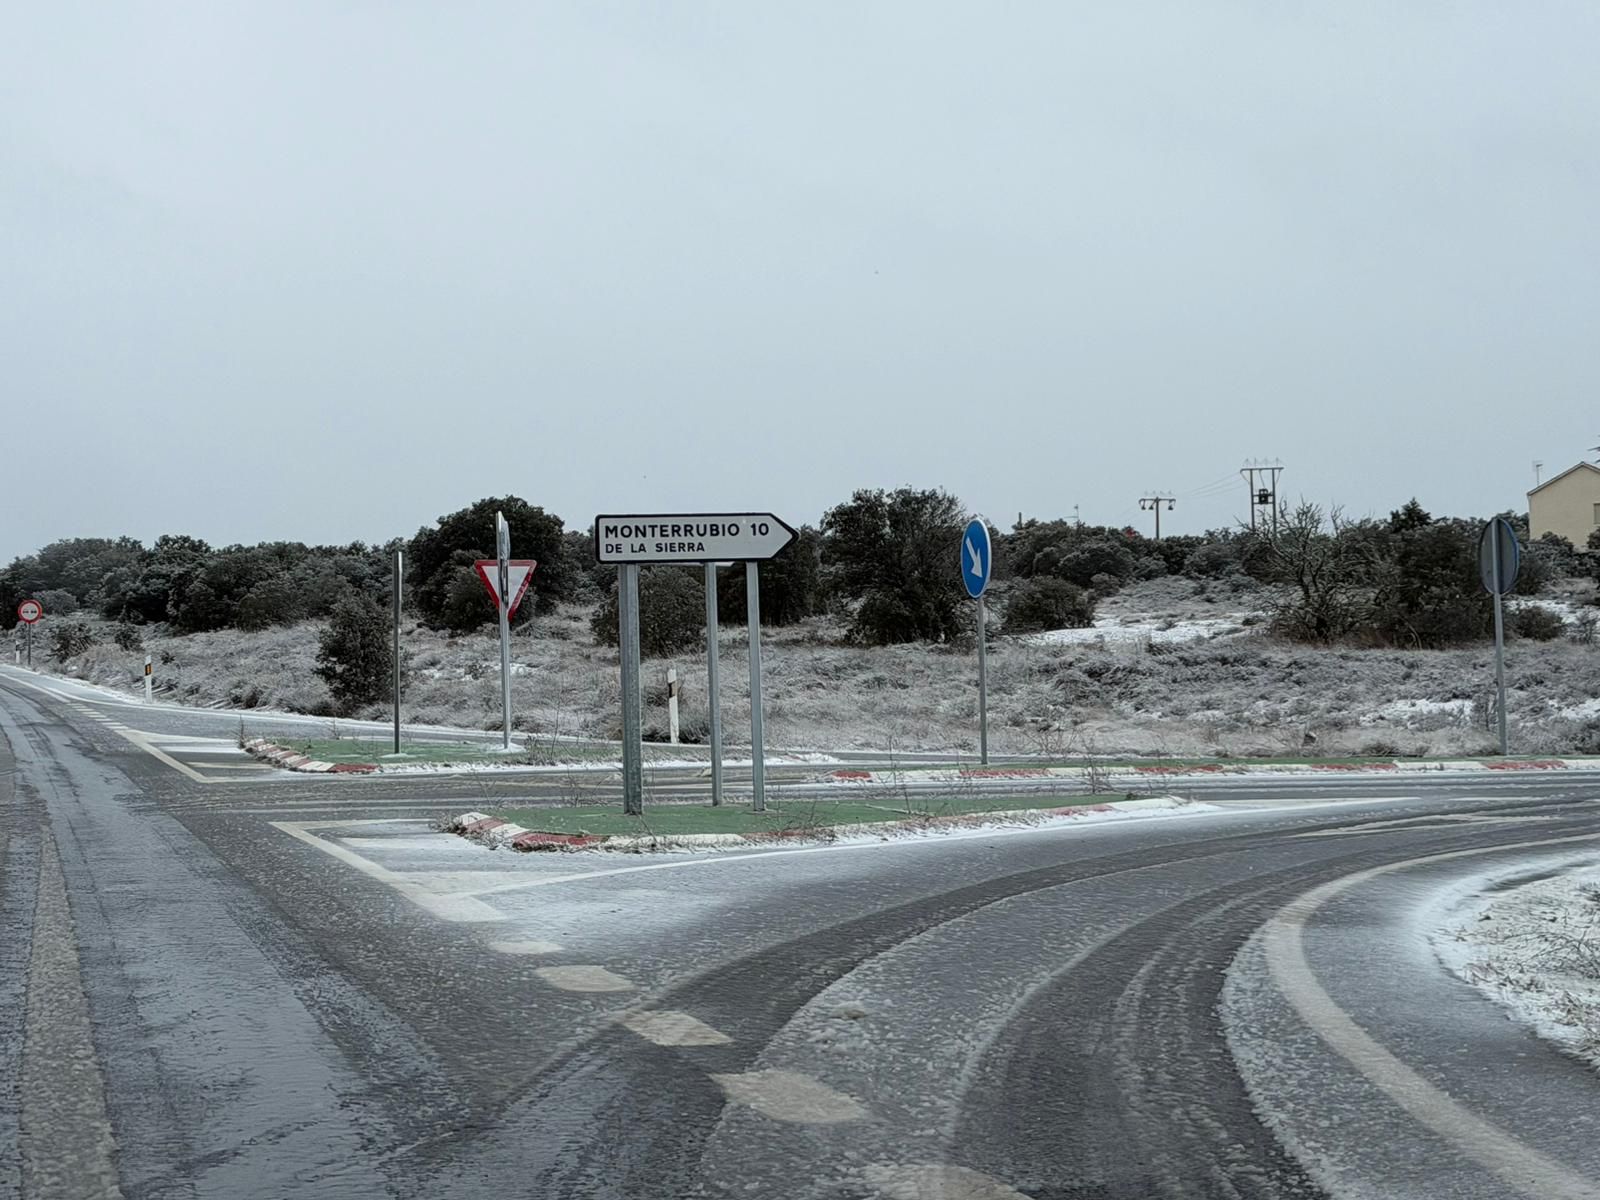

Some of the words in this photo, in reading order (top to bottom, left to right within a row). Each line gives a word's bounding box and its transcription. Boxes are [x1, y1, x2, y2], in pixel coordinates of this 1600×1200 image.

[604, 523, 740, 538] MONTERRUBIO
[750, 523, 769, 536] 10
[605, 543, 623, 553] DE
[630, 543, 647, 553] LA
[655, 542, 705, 553] SIERRA
